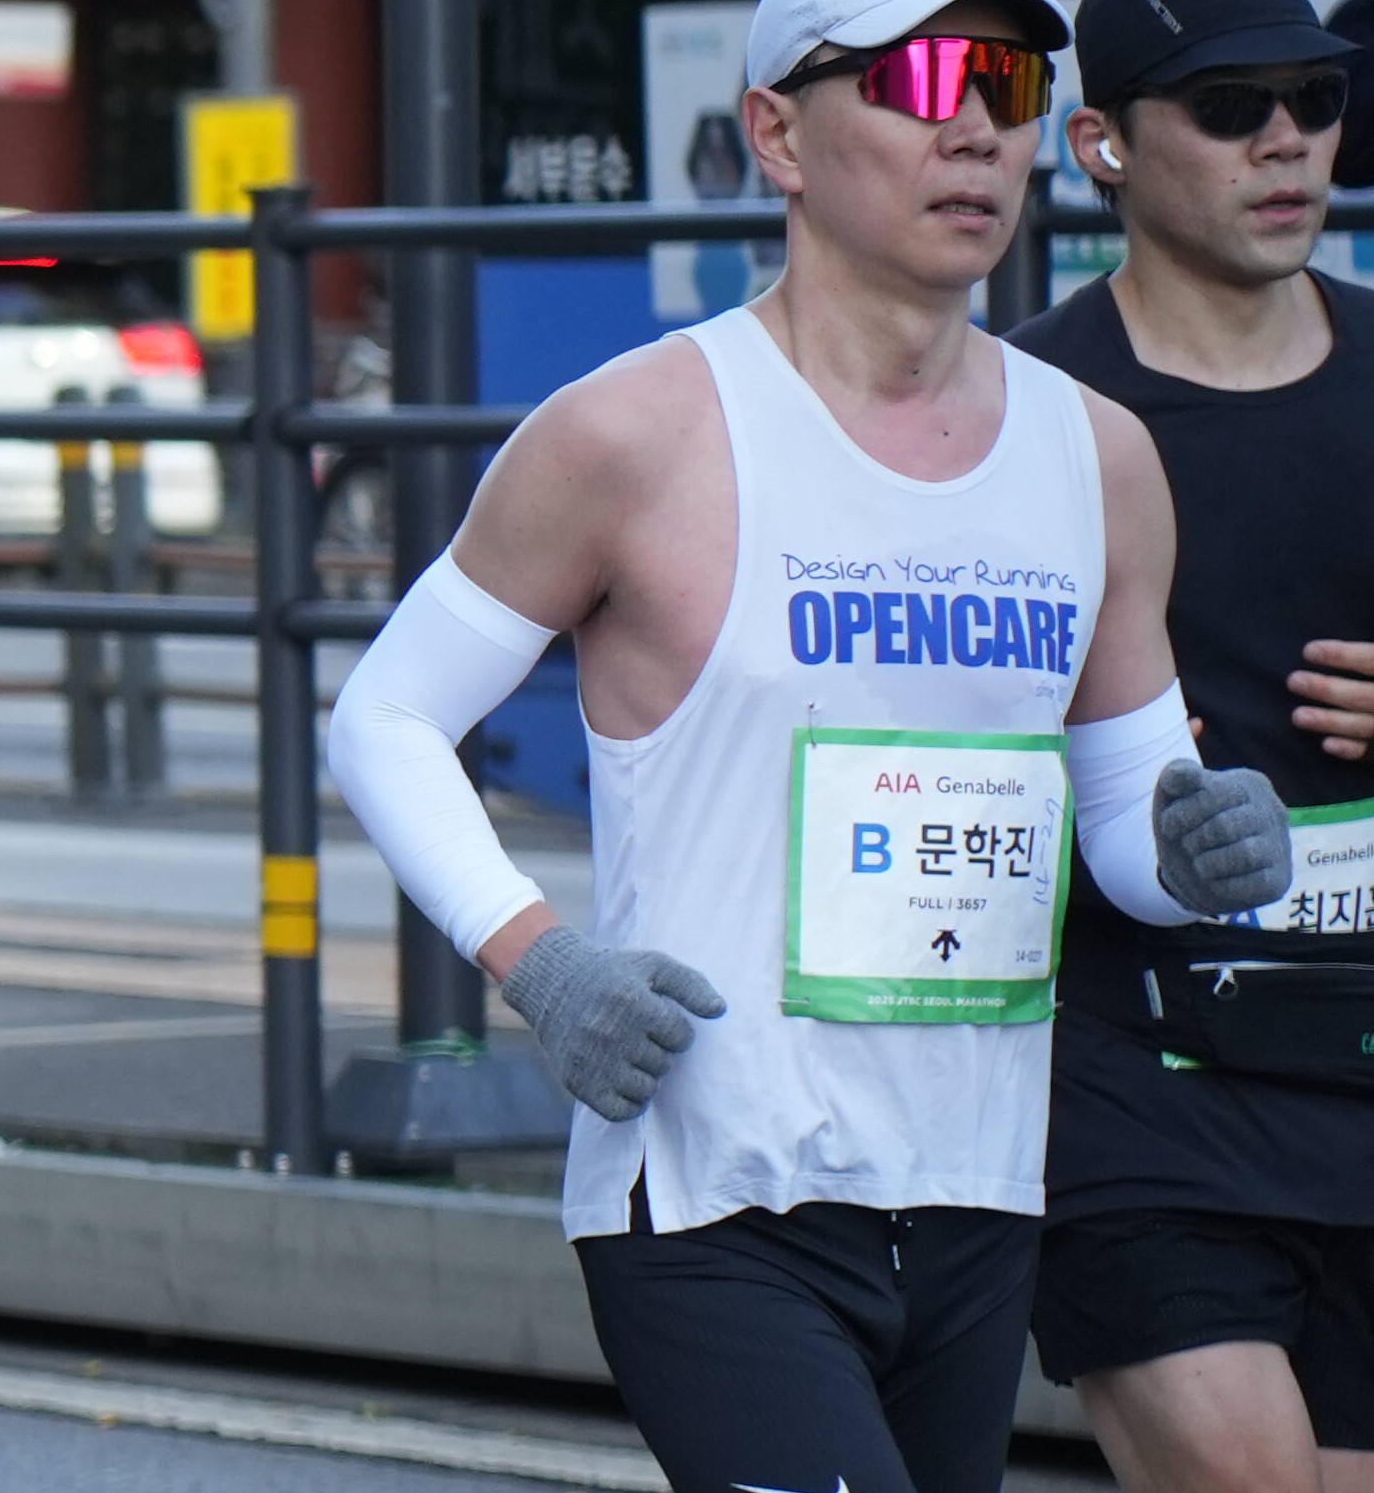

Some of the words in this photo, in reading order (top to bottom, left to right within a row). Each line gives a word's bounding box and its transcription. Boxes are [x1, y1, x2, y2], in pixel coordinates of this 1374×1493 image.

[781, 553, 886, 581] Design
[894, 555, 966, 584] Your
[975, 558, 1075, 594] Running
[788, 590, 1077, 676] OPENCARE
[874, 772, 922, 794] AIA
[936, 776, 1026, 797] Genabelle
[852, 822, 893, 873] B
[915, 823, 1036, 878] 문학진
[909, 896, 944, 909] FULL
[1289, 885, 1374, 935] 최지
